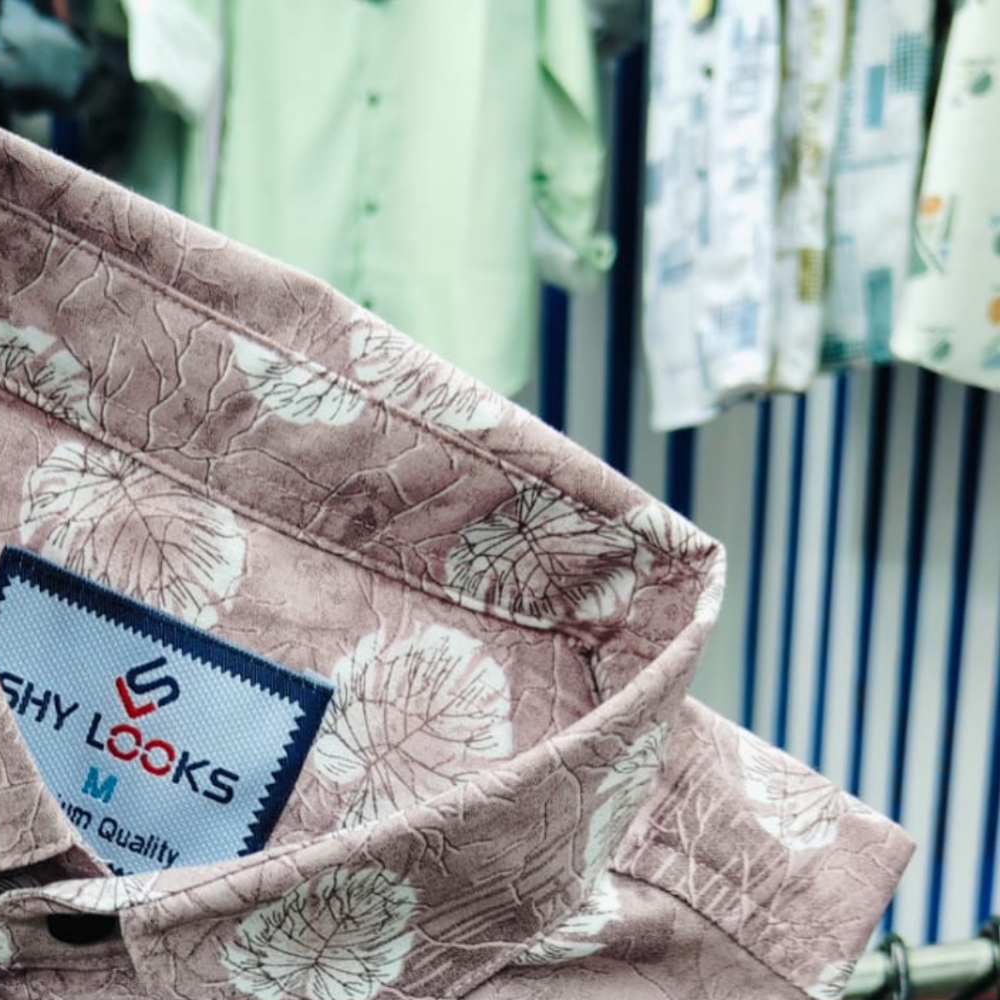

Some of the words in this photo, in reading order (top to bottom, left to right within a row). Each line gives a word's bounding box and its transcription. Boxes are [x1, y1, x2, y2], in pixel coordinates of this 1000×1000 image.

[80, 765, 118, 804] M
[85, 711, 240, 805] LOOKS
[97, 816, 180, 870] Quality
